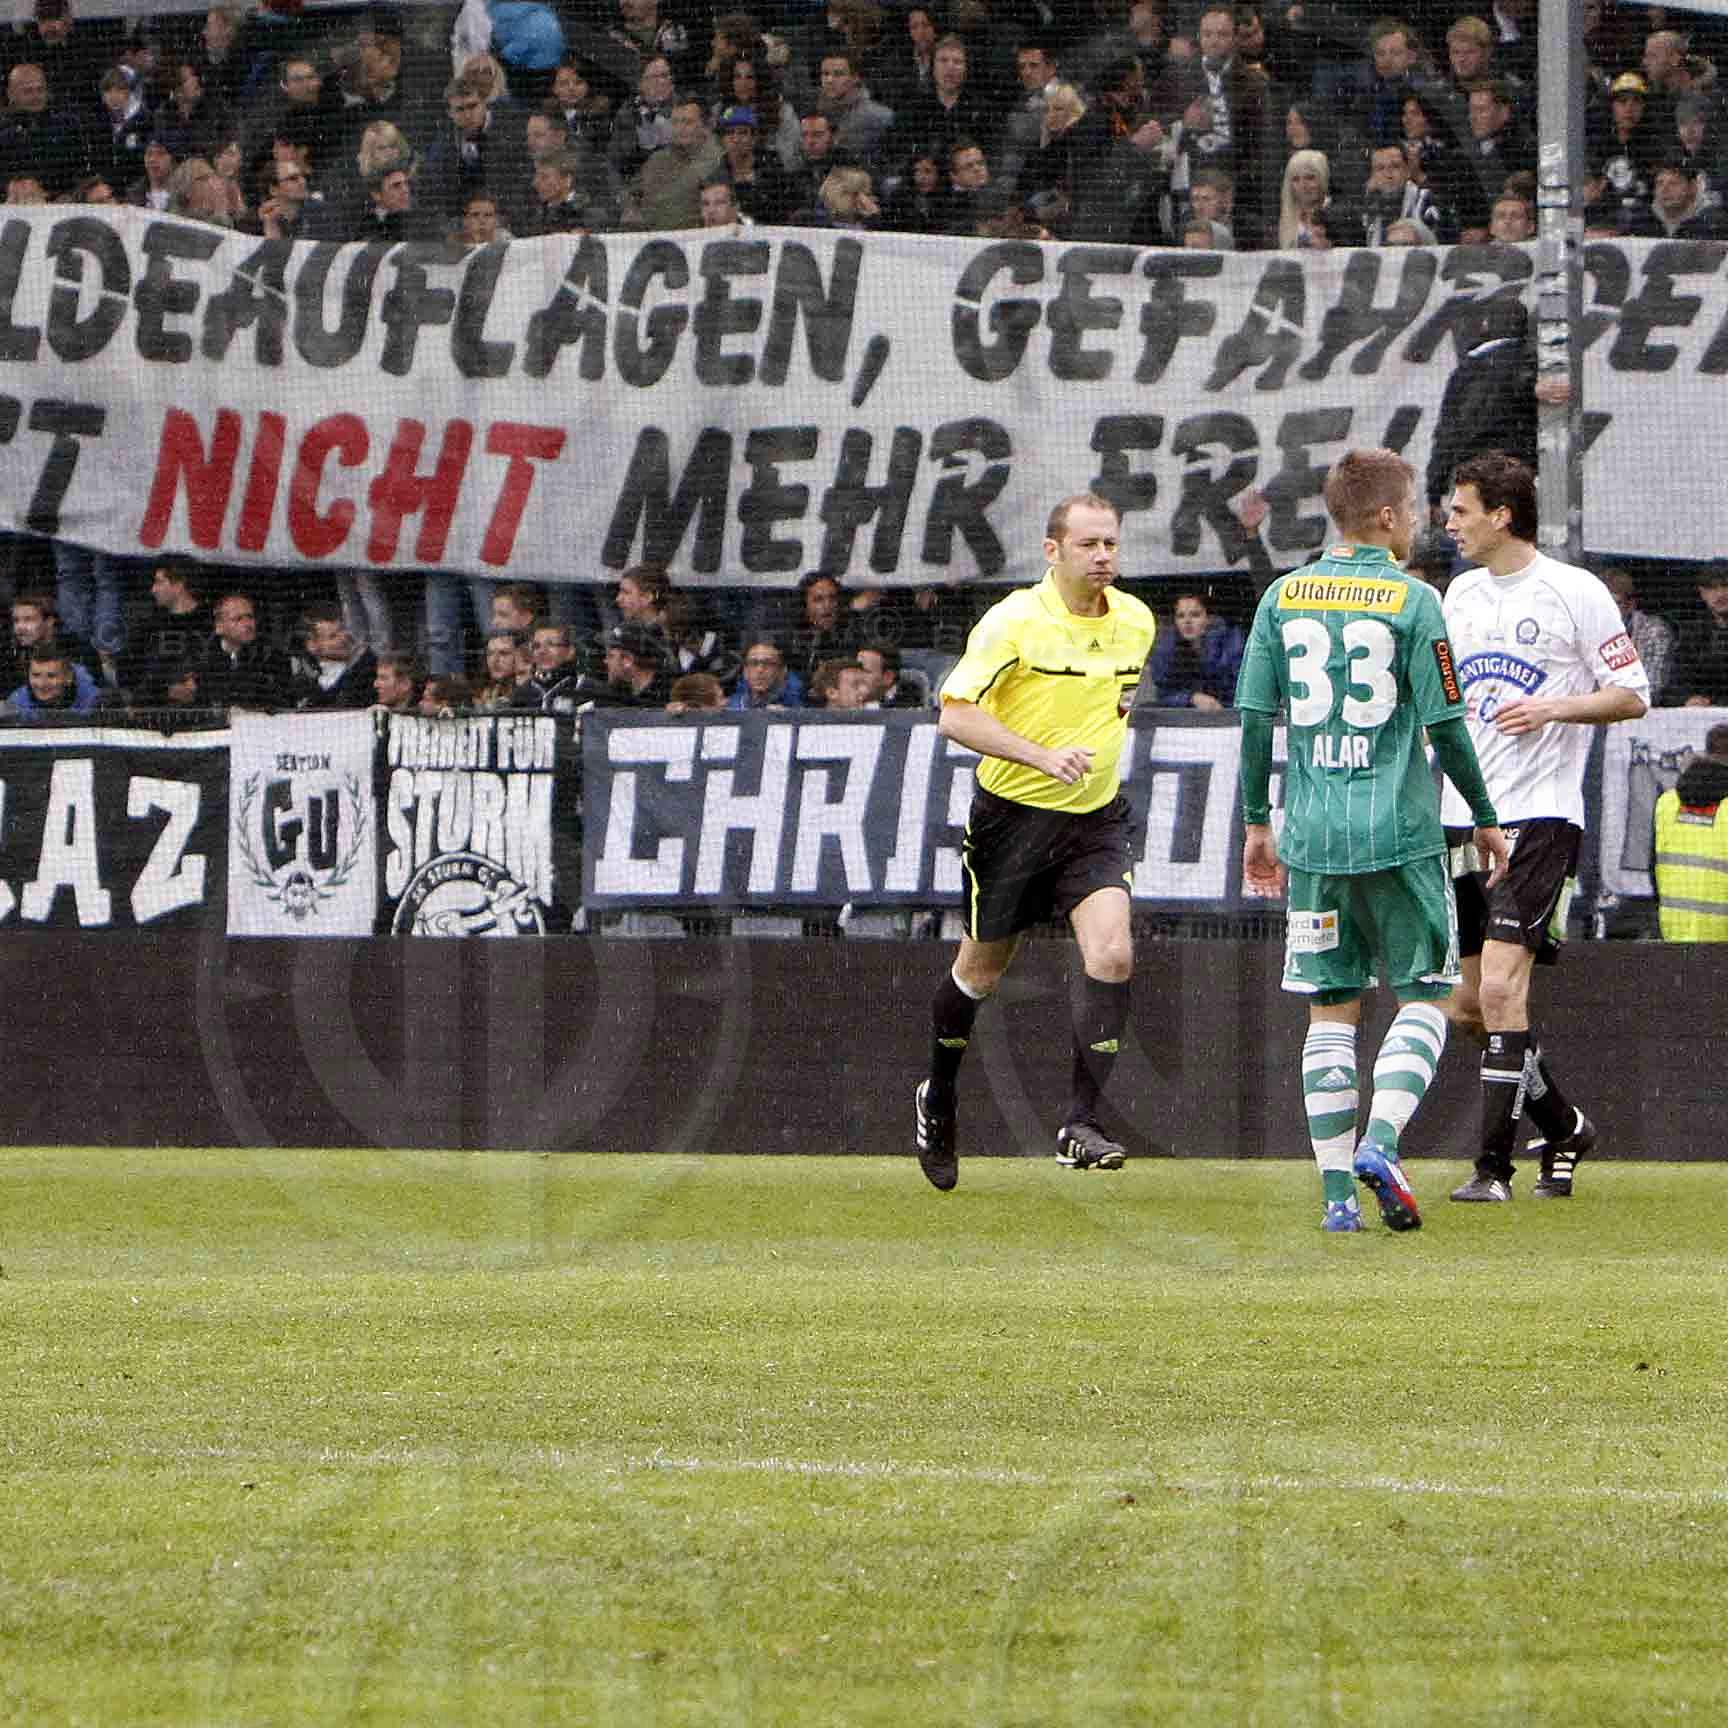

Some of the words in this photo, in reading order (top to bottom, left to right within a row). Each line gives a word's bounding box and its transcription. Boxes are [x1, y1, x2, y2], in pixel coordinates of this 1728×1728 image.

[139, 406, 567, 566] NICHT
[602, 418, 1011, 575] MEHR
[1285, 579, 1397, 605] Ottakringer
[1281, 617, 1398, 728] 33
[1435, 640, 1460, 703] Orange
[1459, 656, 1540, 689] NTIGAMER
[1312, 734, 1370, 768] ALAR
[386, 767, 554, 907] STURM
